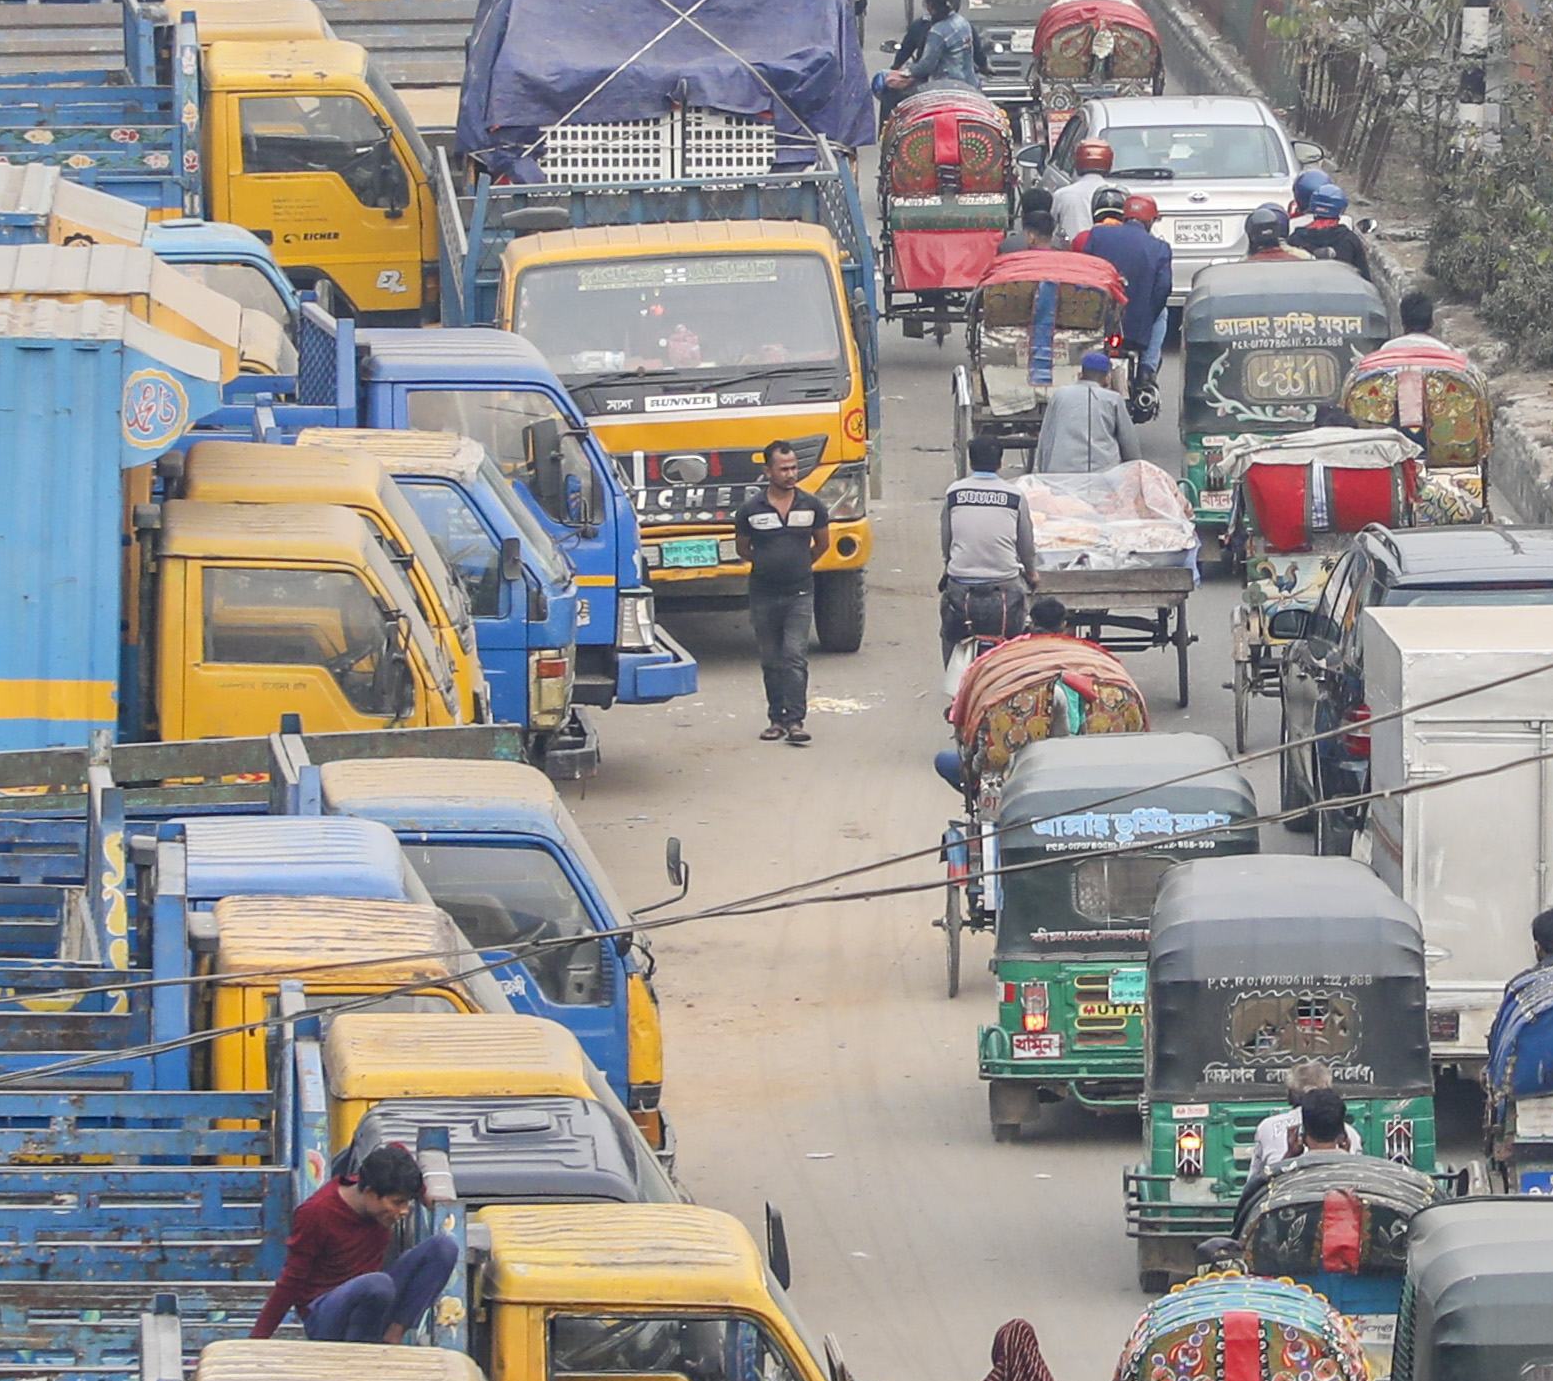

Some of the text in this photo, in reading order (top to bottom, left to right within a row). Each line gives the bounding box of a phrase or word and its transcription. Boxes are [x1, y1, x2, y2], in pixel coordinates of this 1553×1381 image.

[303, 231, 340, 241] EICHER
[1214, 312, 1362, 338] আল্লাহ তুমিই মহান
[650, 396, 712, 408] RUNNER
[636, 486, 761, 510] ICHER
[957, 490, 1008, 505] SQUAD
